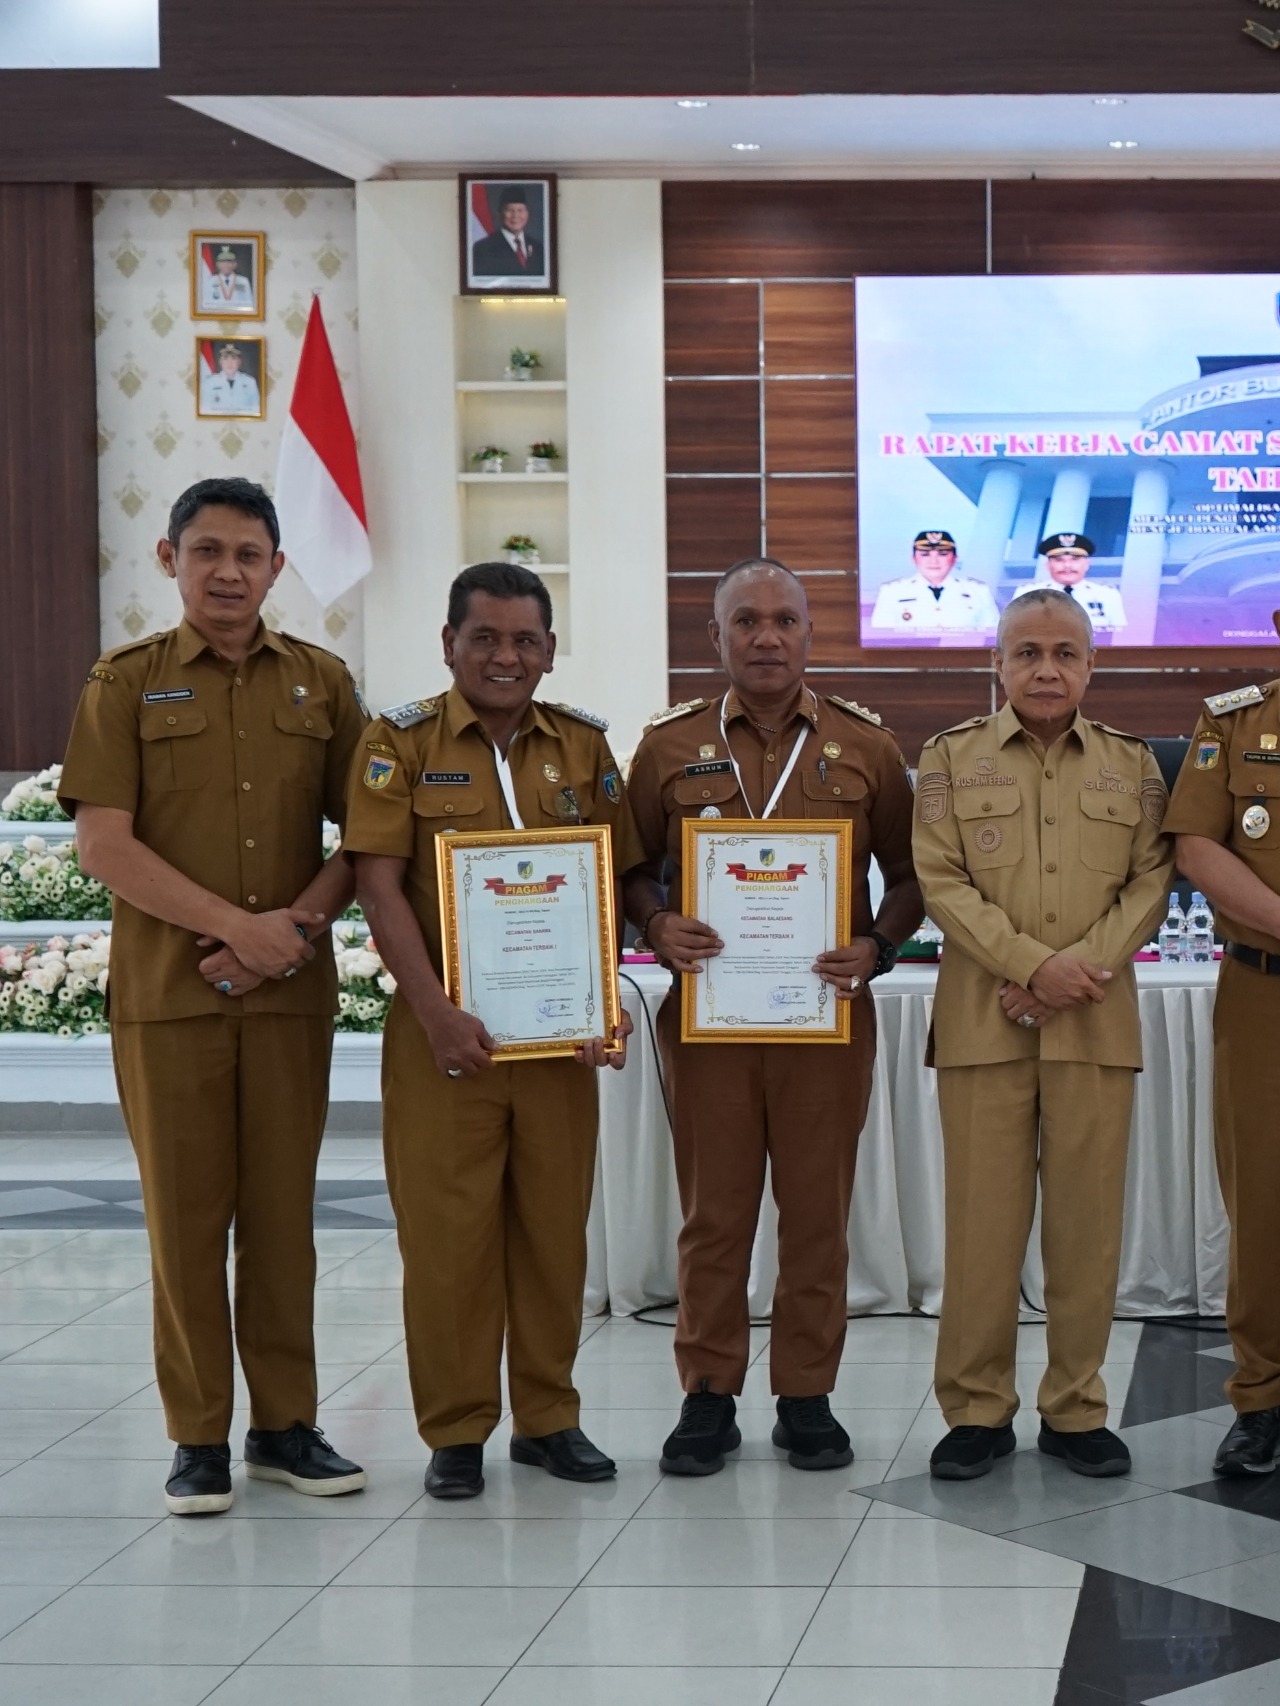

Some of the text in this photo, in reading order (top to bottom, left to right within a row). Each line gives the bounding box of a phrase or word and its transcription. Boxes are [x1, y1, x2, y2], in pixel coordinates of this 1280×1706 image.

[880, 432, 1001, 457] RAPAT
[1003, 431, 1129, 457] KERJA
[1131, 430, 1265, 456] CAMAT
[956, 776, 988, 787] RUSTAM
[989, 775, 1017, 785] EFENDI
[1084, 779, 1138, 795] SEKDA
[746, 872, 788, 881] PIAGAM
[505, 884, 548, 895] PIAGAM
[735, 884, 799, 892] PENGHARGAAN
[494, 896, 560, 906] PENGHARGAAN
